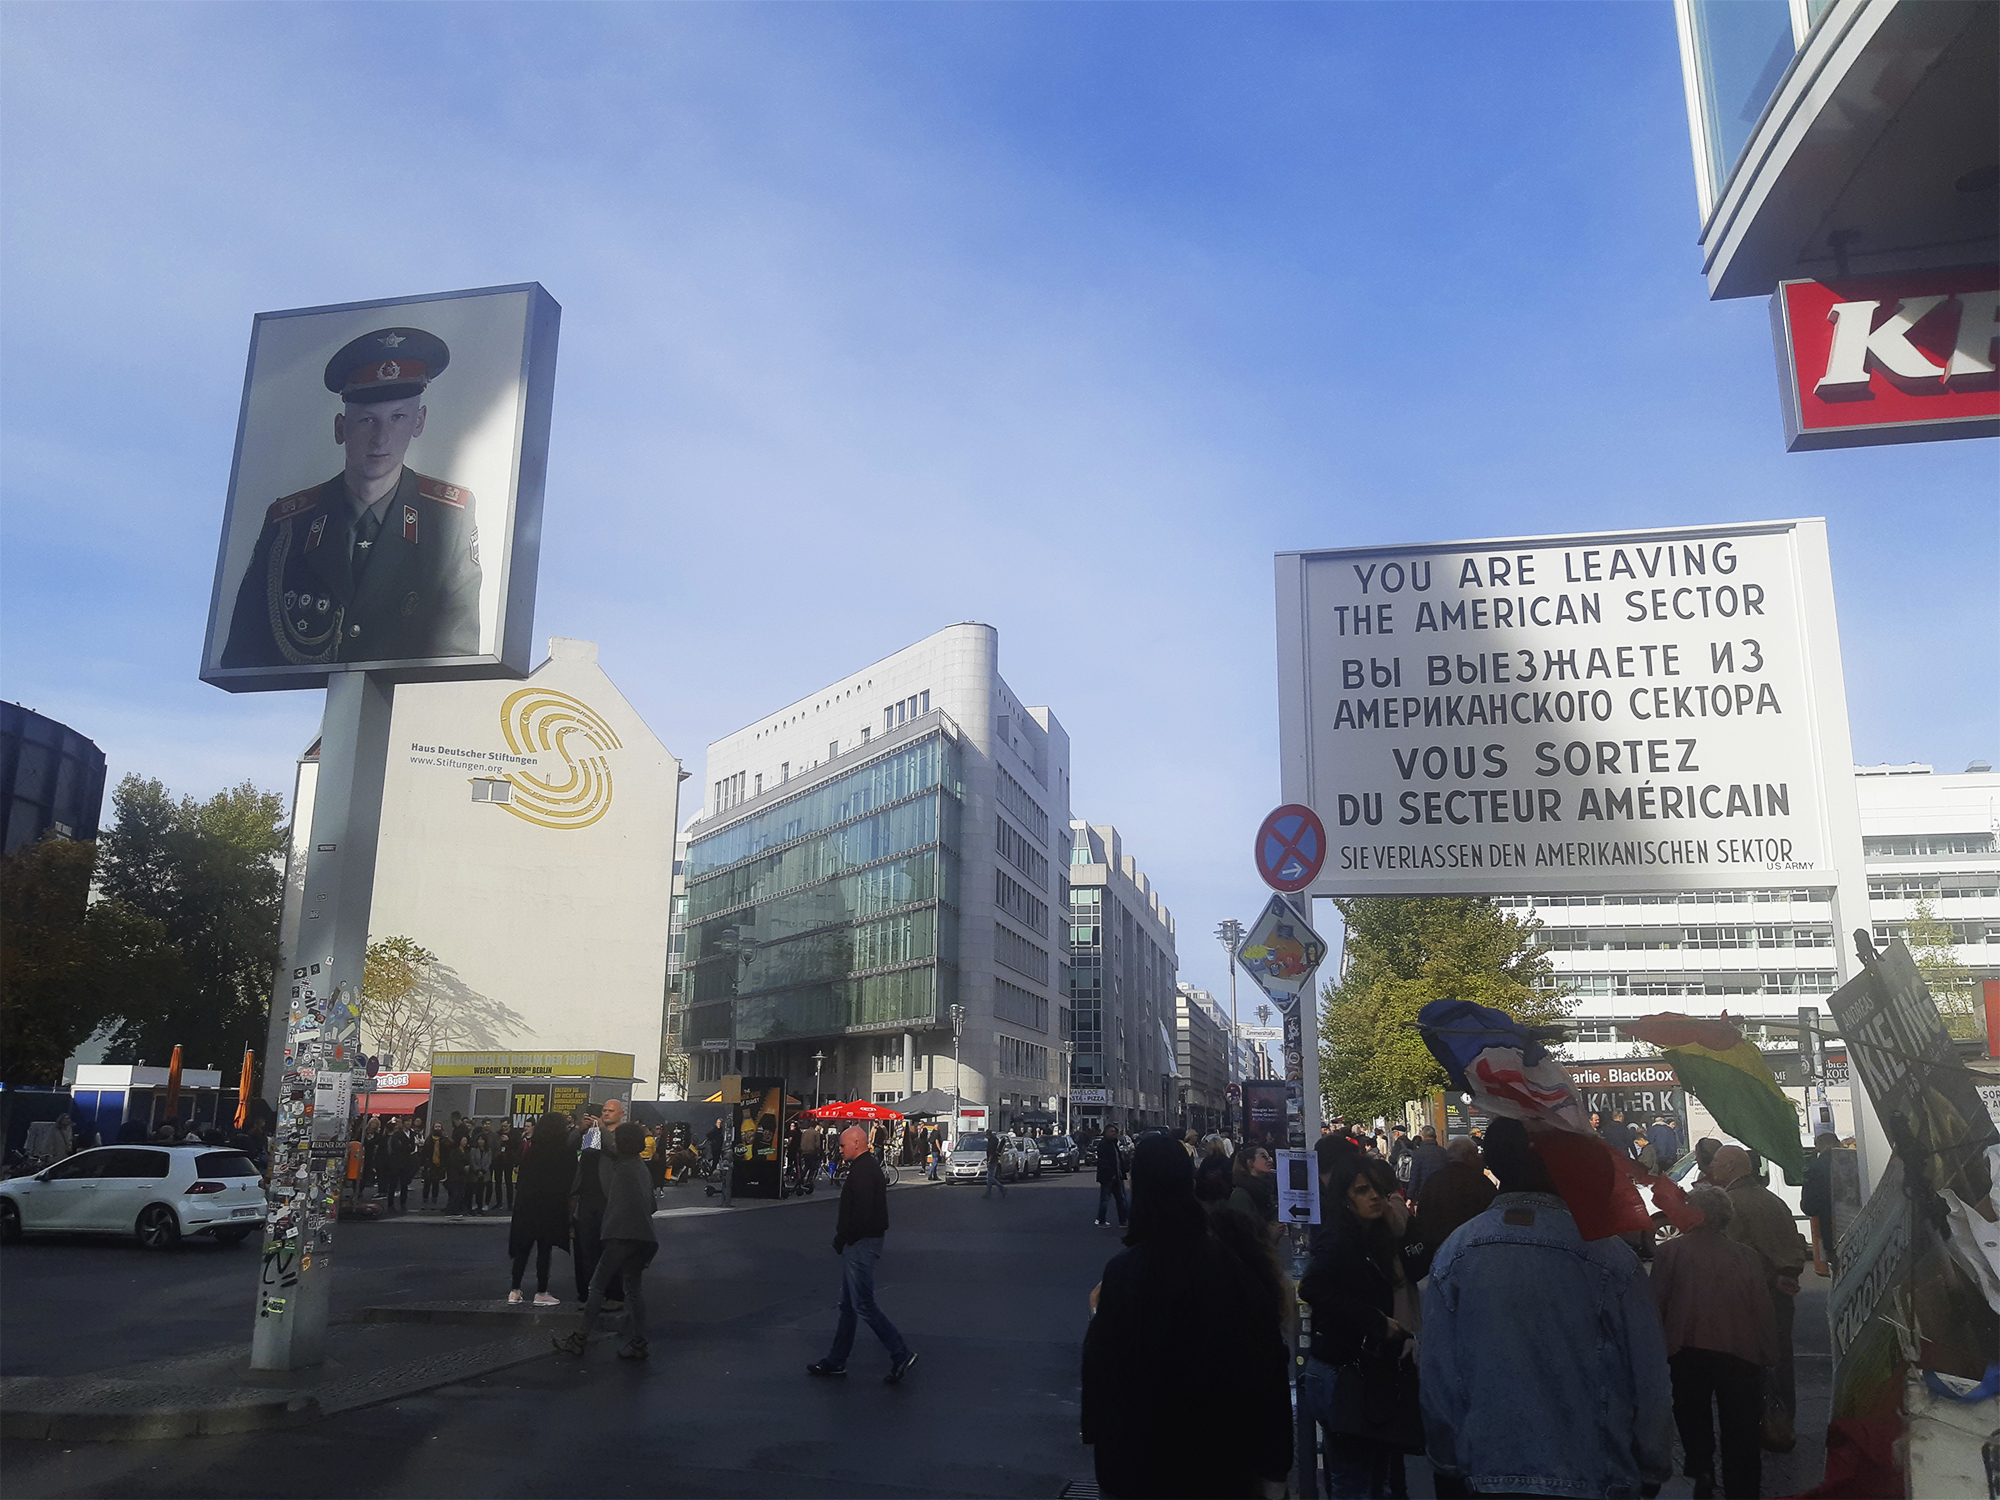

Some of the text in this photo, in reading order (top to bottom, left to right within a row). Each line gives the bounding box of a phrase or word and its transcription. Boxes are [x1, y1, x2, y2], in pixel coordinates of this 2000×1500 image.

[1353, 542, 1737, 595] YOU ARE LEAVING
[1334, 583, 1765, 636] THE AMERICAN SECTOR
[1342, 638, 1764, 690] ВЫ ВЫЕЗЖАЕТЕ ИЗ
[1333, 682, 1783, 730] АМЕРИКАНСКОГО СЕКТОРА
[410, 756, 503, 774] www.Stiftungen.org
[411, 743, 538, 765] Haus Deutscher Stiftungen
[1392, 738, 1700, 780] VOUS SORTEZ
[1338, 779, 1790, 826] DU SECTEUR AMÉRICAIN
[1341, 838, 1793, 870] SIE VERLASSEN DEN AMERIKANISCHEN SEKTOR
[1766, 862, 1814, 870] US ARMY
[1841, 991, 1875, 1032] ANDREAS
[1853, 981, 1941, 1101] KIELING
[473, 1066, 502, 1074] WELCOME
[503, 1066, 511, 1074] TO
[532, 1066, 553, 1074] BERLIN
[511, 1054, 543, 1066] BERLIN
[1572, 1067, 1674, 1084] arlie BlackBox
[515, 1094, 545, 1114] THE
